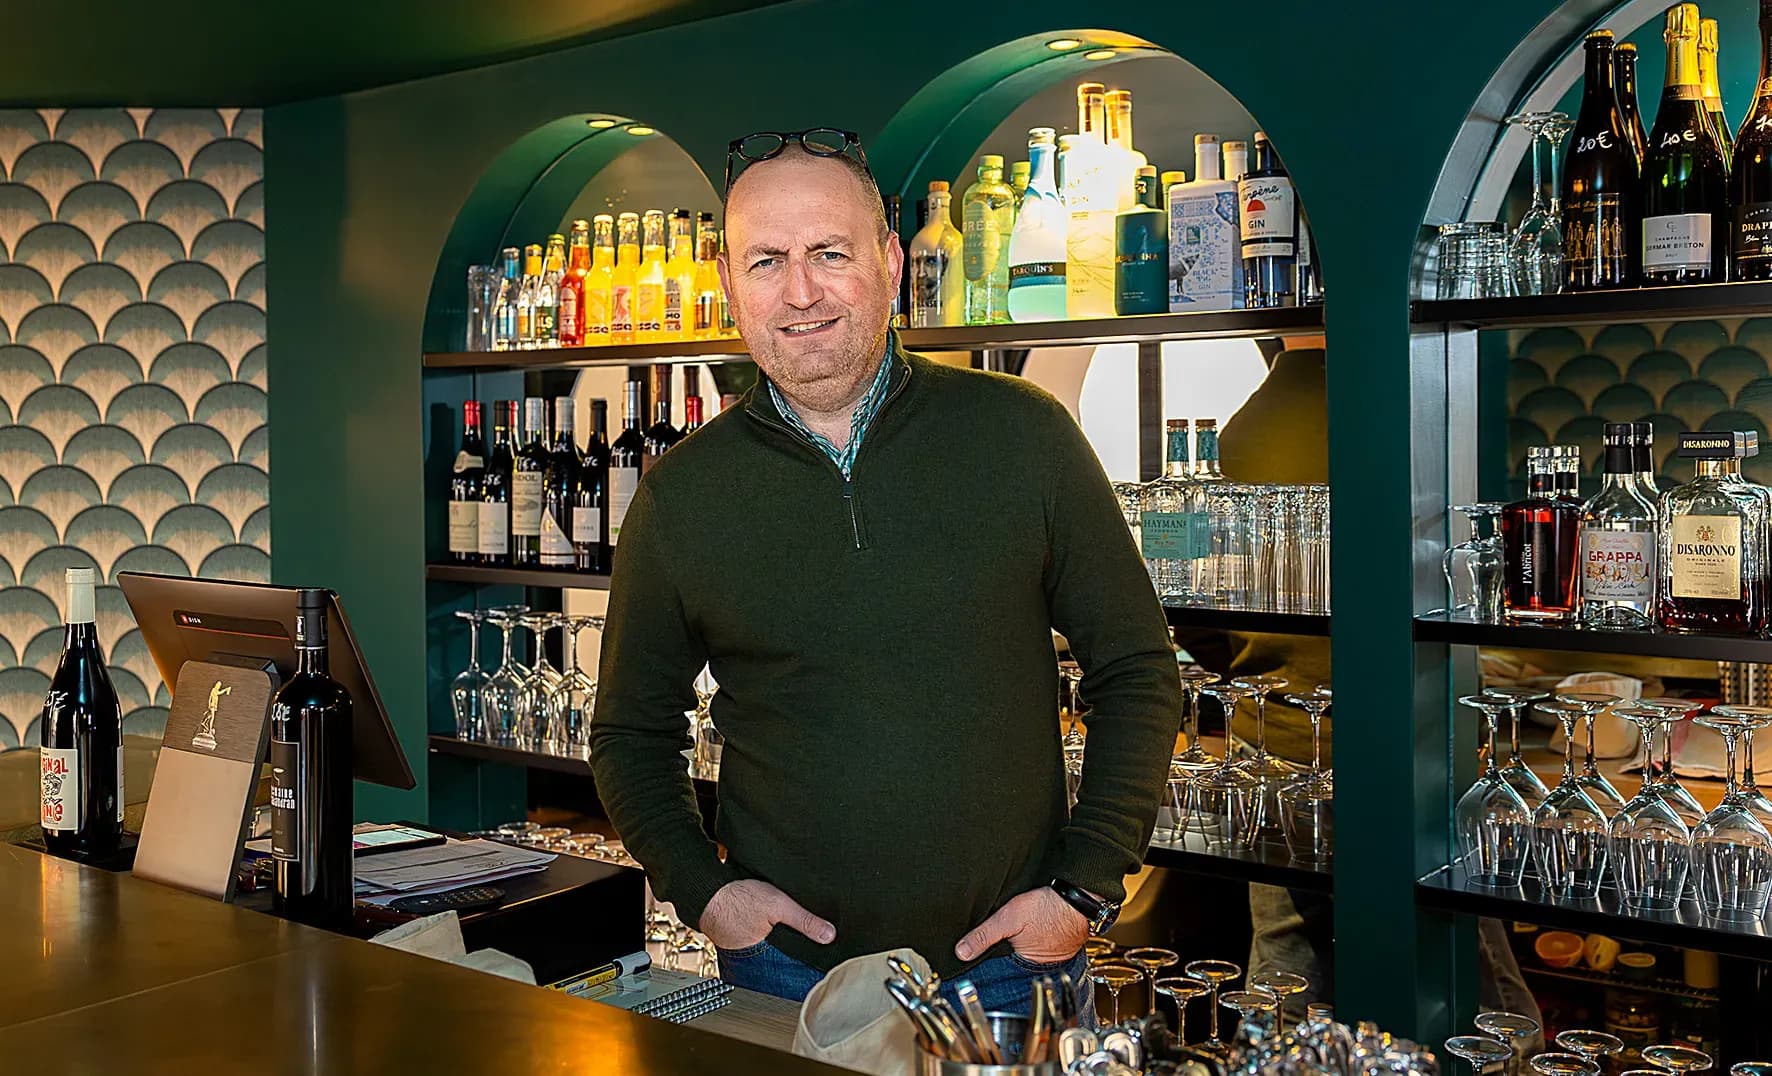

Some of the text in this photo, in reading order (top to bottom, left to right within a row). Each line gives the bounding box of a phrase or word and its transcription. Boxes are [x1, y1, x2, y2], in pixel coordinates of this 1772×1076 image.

[1577, 130, 1613, 154] 20€
[1248, 219, 1265, 229] GIN
[1683, 439, 1730, 449] DISARONNO
[1588, 550, 1643, 562] GRAPPA
[1677, 543, 1736, 557] DISARONNO
[1522, 543, 1533, 584] l'Abricot
